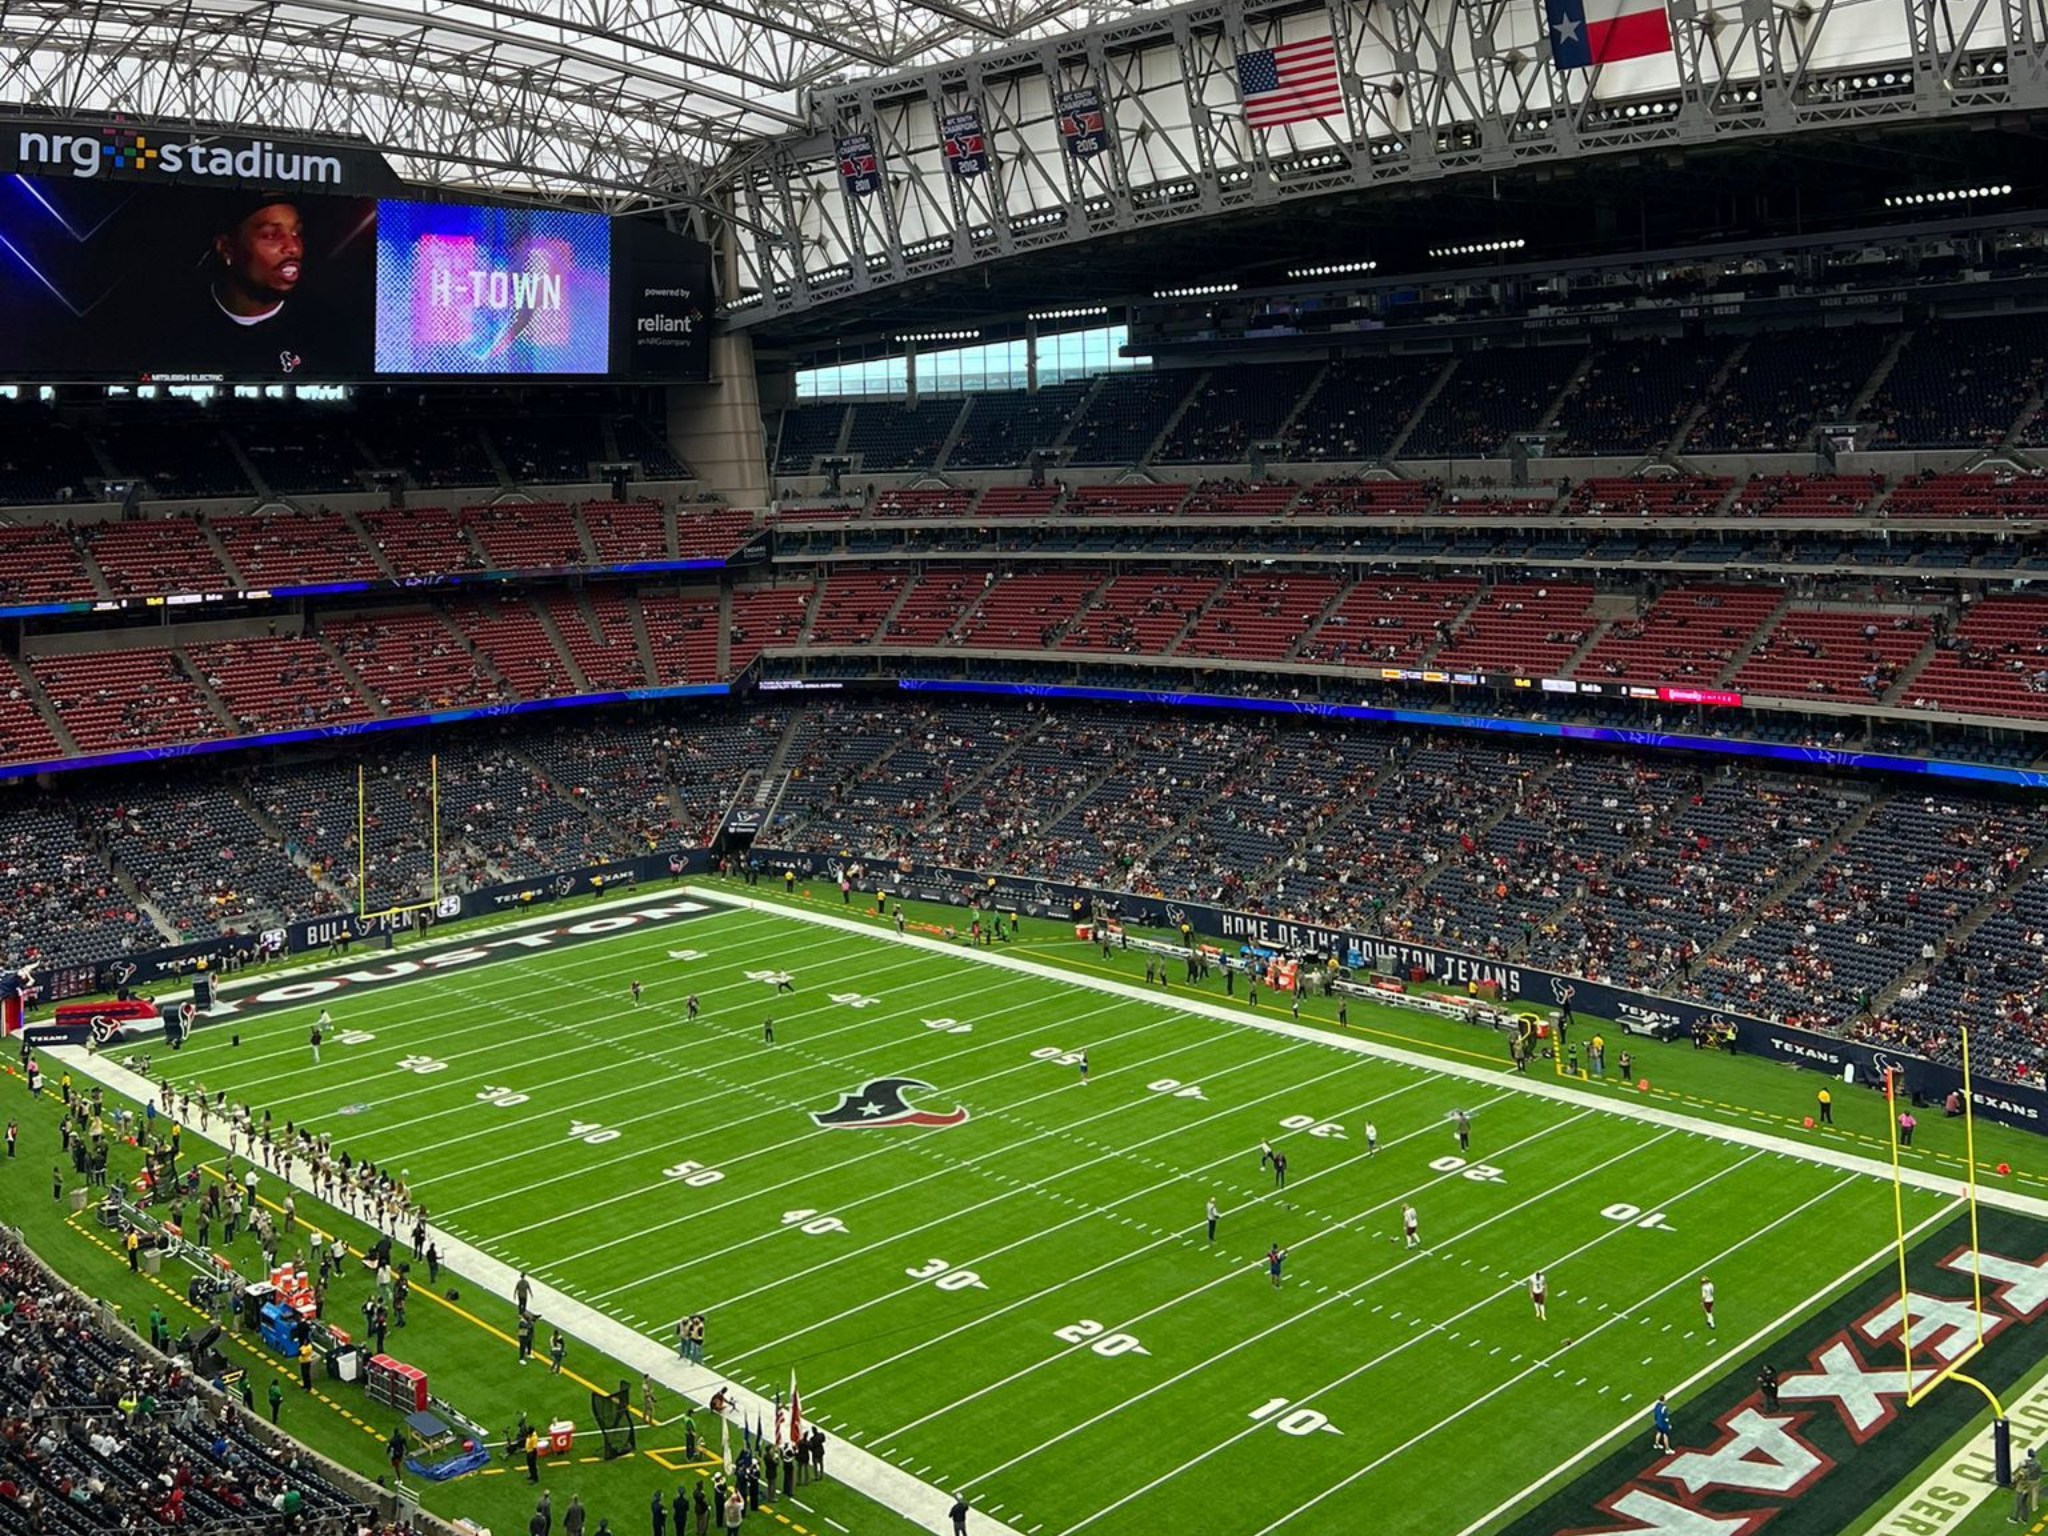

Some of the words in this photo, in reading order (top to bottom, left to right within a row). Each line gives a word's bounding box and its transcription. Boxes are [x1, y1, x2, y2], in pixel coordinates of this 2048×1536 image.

[19, 132, 101, 178] nrg
[159, 141, 341, 184] stadium
[1076, 137, 1099, 152] 2015
[958, 159, 979, 173] 2012
[430, 270, 561, 310] H-TOWN
[645, 287, 678, 298] powered
[679, 289, 690, 299] by
[637, 314, 692, 332] reliant
[441, 898, 458, 915] 25
[307, 919, 348, 946] BULL
[380, 912, 413, 932] PEN
[1222, 914, 1269, 942] HOME
[1277, 926, 1299, 947] OF
[1445, 956, 1521, 993] TEXANS
[30, 1034, 69, 1043] TEXANS
[1771, 1038, 1840, 1065] TEXANS
[396, 1055, 449, 1075] 20
[476, 1086, 531, 1107] 30
[1958, 1087, 2039, 1120] TEXANS
[567, 1122, 622, 1144] 40
[1279, 1115, 1343, 1139] 30
[662, 1160, 725, 1188] 50
[1429, 1155, 1500, 1183] 20
[781, 1208, 842, 1235] 40
[1600, 1203, 1668, 1231] 10
[905, 1258, 980, 1291] 30
[1053, 1319, 1140, 1357] 20
[1248, 1397, 1328, 1436] 10
[556, 1434, 568, 1447] G
